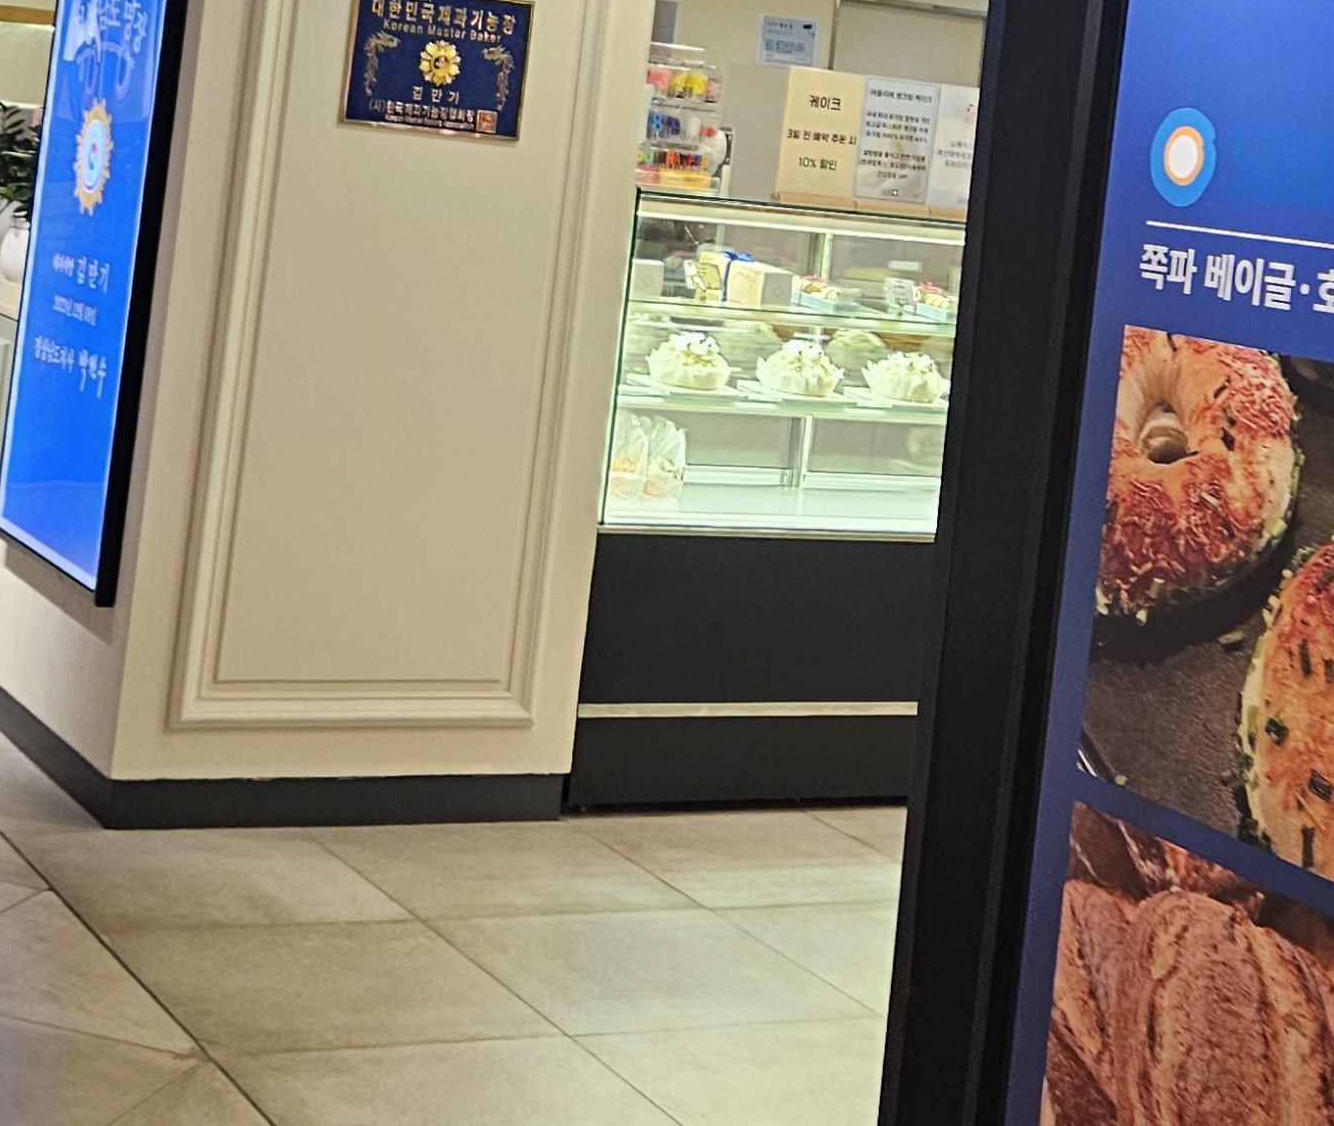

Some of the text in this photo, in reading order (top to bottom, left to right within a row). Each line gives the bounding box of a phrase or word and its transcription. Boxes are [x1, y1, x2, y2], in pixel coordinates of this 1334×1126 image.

[384, 20, 502, 44] Korean Master Baker
[798, 156, 817, 169] 10%
[1139, 243, 1198, 292] 쪽파
